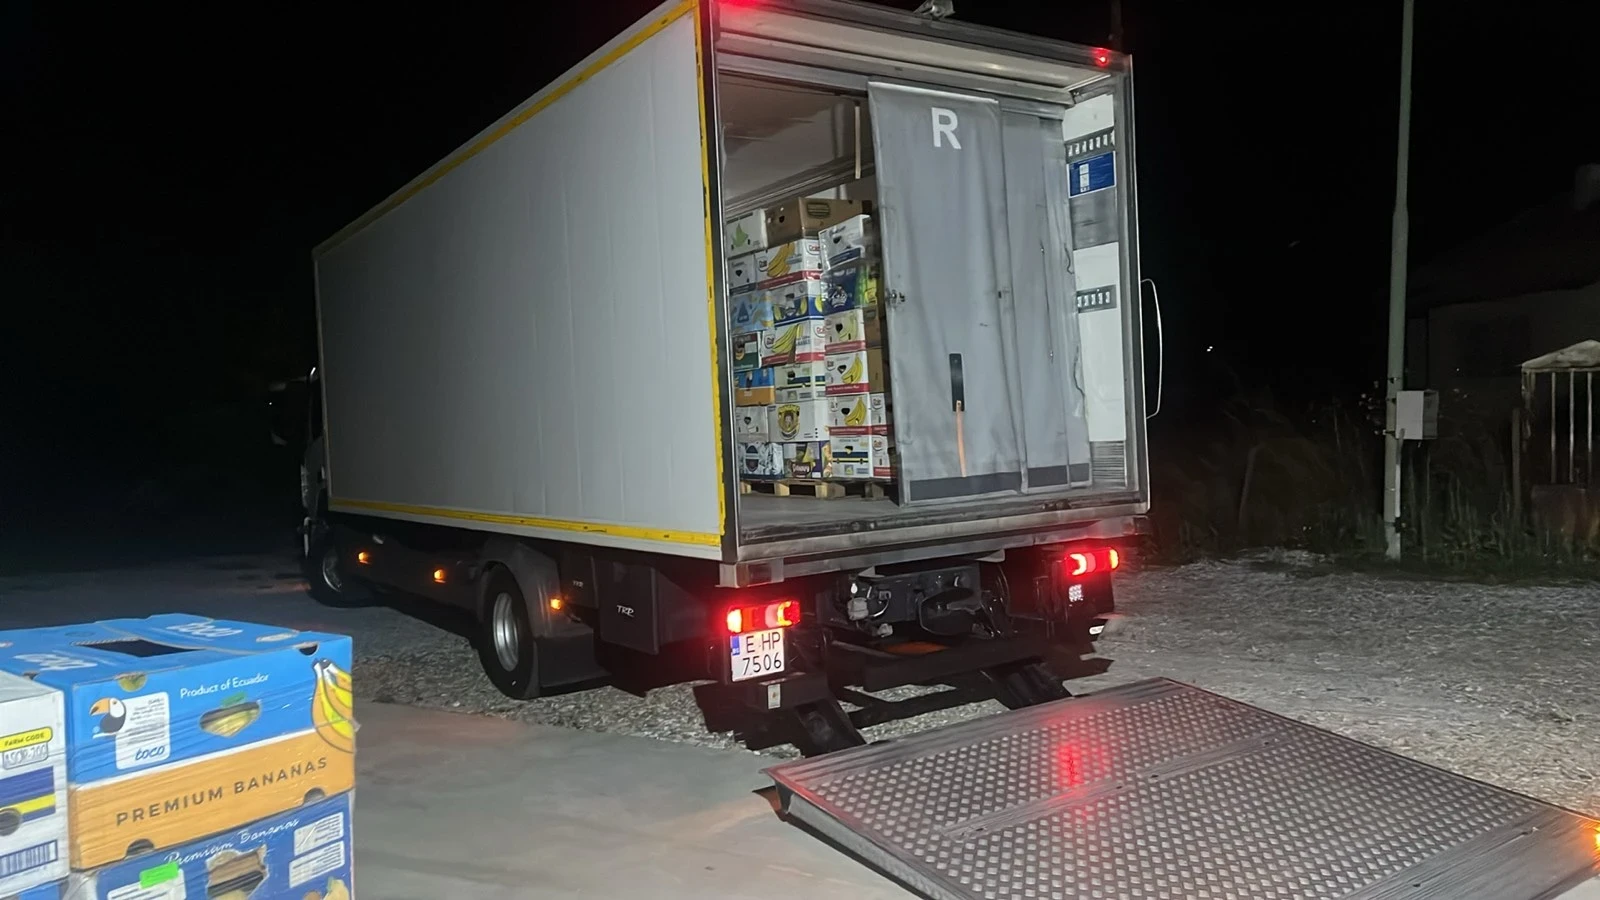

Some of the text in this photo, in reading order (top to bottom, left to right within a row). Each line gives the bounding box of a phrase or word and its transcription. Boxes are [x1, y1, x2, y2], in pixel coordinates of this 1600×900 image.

[931, 107, 962, 149] R
[616, 604, 635, 618] TRP
[746, 635, 756, 653] E
[761, 631, 781, 651] HP
[742, 651, 782, 676] 7506
[179, 673, 270, 699] Product of Ecuador
[134, 745, 166, 761] toco
[116, 756, 328, 827] PREMIUM BANANAS
[236, 817, 300, 845] Bananas
